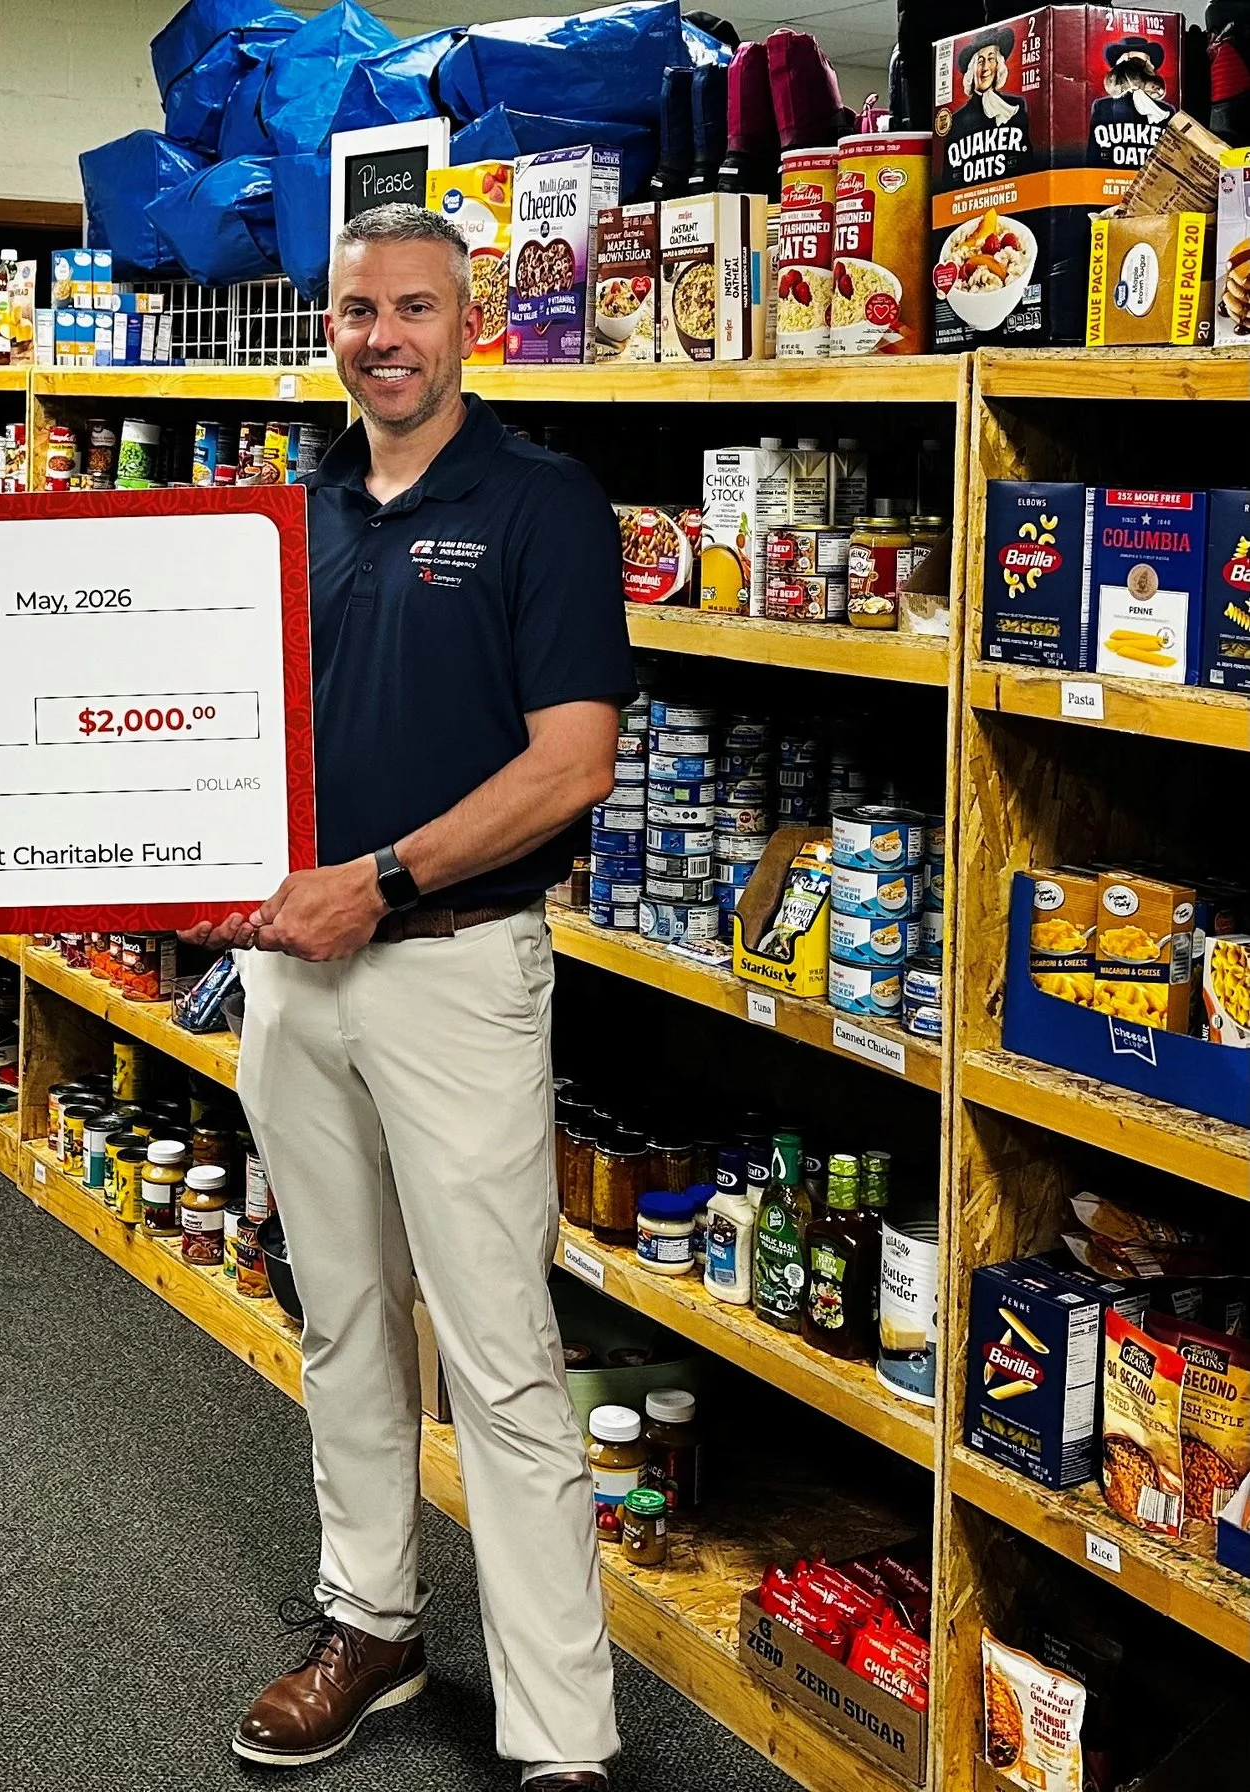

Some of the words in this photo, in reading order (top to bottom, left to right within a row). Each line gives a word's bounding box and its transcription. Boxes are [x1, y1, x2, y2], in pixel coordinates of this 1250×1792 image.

[1028, 16, 1036, 38] 2
[1106, 14, 1114, 31] 2
[1022, 41, 1027, 53] 5
[1030, 37, 1040, 50] LB
[1022, 50, 1040, 66] BAGS
[1022, 69, 1035, 85] 110
[1094, 123, 1167, 148] QUAKE
[948, 127, 1024, 168] QUAKER
[963, 154, 1006, 182] OATS
[358, 164, 414, 198] Please
[539, 178, 556, 194] Multi
[556, 178, 578, 194] Grain
[520, 190, 576, 222] Cheerios
[952, 200, 968, 214] OLD
[968, 190, 1018, 211] FASHIONED
[670, 234, 699, 244] OATMEAL
[672, 222, 698, 234] INSTANT
[784, 222, 830, 236] FASHIONED
[834, 226, 859, 251] ATS
[1186, 226, 1199, 245] 20
[607, 240, 632, 252] MAPLE
[634, 239, 640, 248] &
[1094, 232, 1104, 250] 20
[598, 252, 624, 264] BROWN
[626, 249, 651, 260] SUGAR
[1092, 256, 1103, 297] PACK
[1182, 250, 1198, 289] PACK
[550, 304, 576, 314] MINERALS
[1090, 298, 1102, 342] VALUE
[1177, 294, 1194, 338] VALUE
[1198, 321, 1210, 339] 20
[706, 474, 750, 486] CHICKEN
[712, 489, 744, 502] STOCK
[1018, 498, 1046, 507] ELBOWS
[1134, 493, 1158, 502] MORE
[1160, 494, 1180, 503] FREE
[457, 542, 487, 552] BUREAU
[1103, 528, 1191, 552] COLUMBIA
[451, 560, 476, 569] Agency
[1005, 550, 1054, 568] Barilla
[16, 591, 68, 614] May,
[74, 588, 132, 609] 2026
[1129, 606, 1154, 616] PENNE
[1068, 692, 1095, 706] Pasta
[78, 705, 216, 738] $2,000.00
[196, 776, 261, 792] DOLLARS
[13, 843, 134, 866] Charitable
[142, 842, 202, 862] Fund
[740, 958, 783, 982] StarKist
[1064, 959, 1088, 967] CHEESE
[1100, 967, 1130, 975] MACARONI
[1131, 968, 1136, 976] &
[1138, 968, 1161, 976] CHEESE
[752, 1001, 772, 1014] Tuna
[836, 1026, 866, 1048] Canned
[867, 1039, 901, 1061] Chicken
[1114, 1026, 1149, 1044] cheese
[759, 1232, 778, 1247] GARLIC
[778, 1240, 798, 1253] BASIL
[566, 1250, 600, 1278] Condiments
[883, 1259, 914, 1287] Butter
[881, 1276, 918, 1303] Powder
[1002, 1294, 1031, 1313] PENNE
[989, 1347, 1037, 1380] Barilla
[1122, 1346, 1152, 1375] GRAINS
[1180, 1346, 1225, 1371] GRAINS
[1190, 1345, 1218, 1360] Earthly
[1107, 1360, 1117, 1380] 90
[1120, 1368, 1156, 1406] SECOND
[1184, 1368, 1238, 1402] SECOND
[1204, 1408, 1245, 1428] STYLE
[1091, 1540, 1114, 1564] Rice
[759, 1617, 773, 1640] G
[748, 1629, 784, 1668] ZERO
[863, 1658, 916, 1697] CHICKEN
[796, 1664, 841, 1709] ZERO
[844, 1696, 906, 1753] SUGAR
[1030, 1690, 1072, 1715] Gourmet
[1030, 1715, 1050, 1735] STYLE
[1052, 1726, 1070, 1741] RICE
[1034, 1706, 1066, 1730] SPANISH
